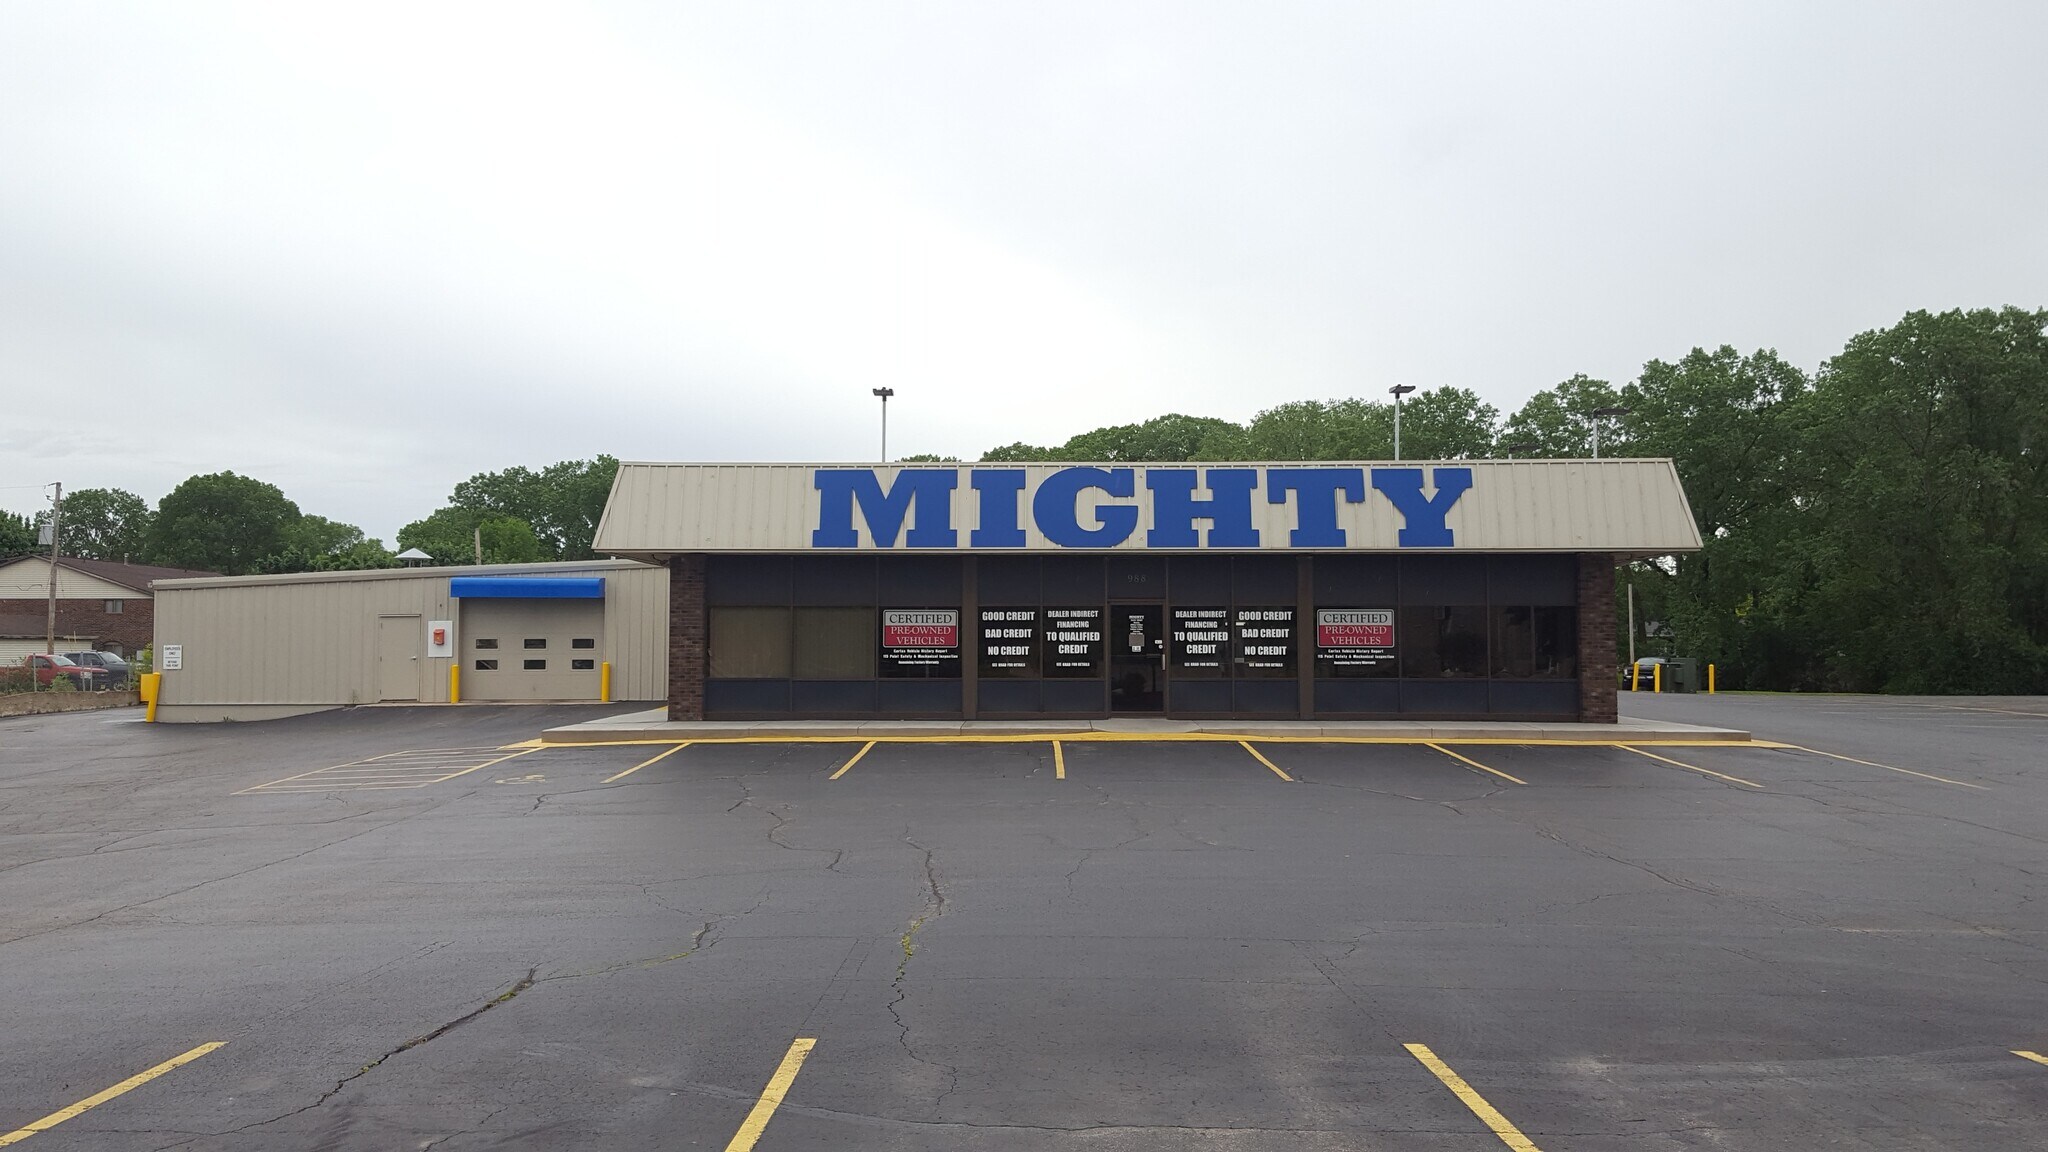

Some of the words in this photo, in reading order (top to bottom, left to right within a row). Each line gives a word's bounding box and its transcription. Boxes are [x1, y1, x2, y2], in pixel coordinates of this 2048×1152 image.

[812, 467, 1473, 548] MIGHTY
[889, 614, 952, 623] CERTIFIED
[982, 612, 1004, 620] GOOD
[1006, 612, 1035, 620] CREDIT
[1239, 611, 1261, 620] GOOD
[1263, 611, 1292, 620] CREDIT
[1324, 614, 1387, 623] CERTIFIED
[985, 629, 1002, 638] BAD
[1003, 629, 1032, 638] CREDIT
[1242, 629, 1258, 638] BAD
[1260, 629, 1289, 638] CREDIT
[1325, 626, 1387, 634] PRE-OWNED
[897, 637, 945, 645] VEHICLES
[1046, 632, 1057, 642] TO
[1059, 632, 1100, 642] QUALIFIED
[1174, 632, 1185, 642] TO
[1187, 632, 1228, 642] QUALIFIED
[988, 646, 999, 655] NO
[1001, 646, 1029, 655] CREDIT
[1058, 644, 1088, 654] CREDIT
[1186, 644, 1216, 654] CREDIT
[1244, 646, 1256, 655] NO
[1258, 646, 1287, 655] CREDIT
